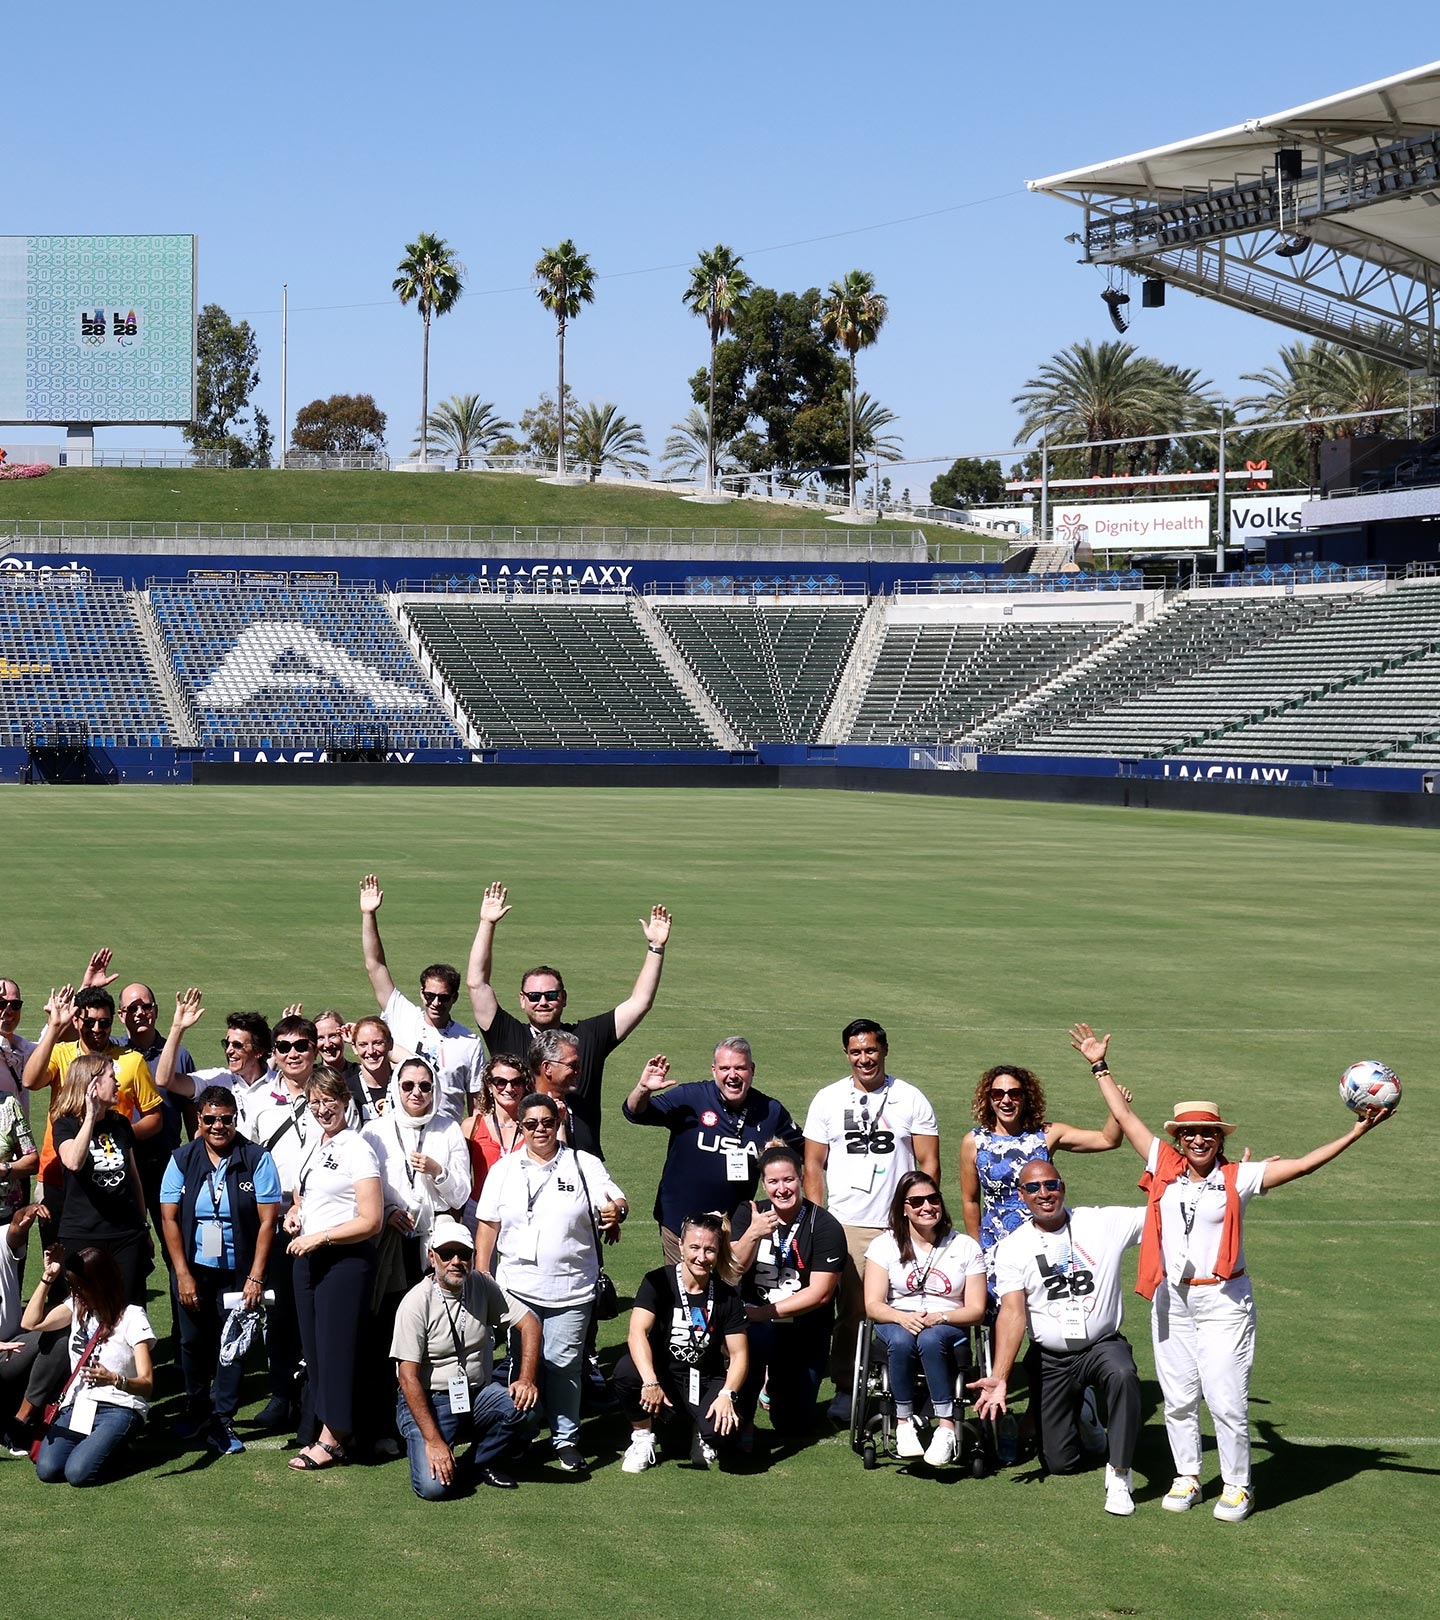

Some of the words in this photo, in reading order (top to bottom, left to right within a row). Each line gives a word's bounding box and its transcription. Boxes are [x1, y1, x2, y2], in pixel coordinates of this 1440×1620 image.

[1095, 518, 1149, 536] Dignity
[1154, 515, 1204, 531] Health
[697, 1131, 759, 1159] USA
[844, 1131, 895, 1154] 28
[323, 1162, 339, 1170] 28
[1044, 1270, 1095, 1300] 28
